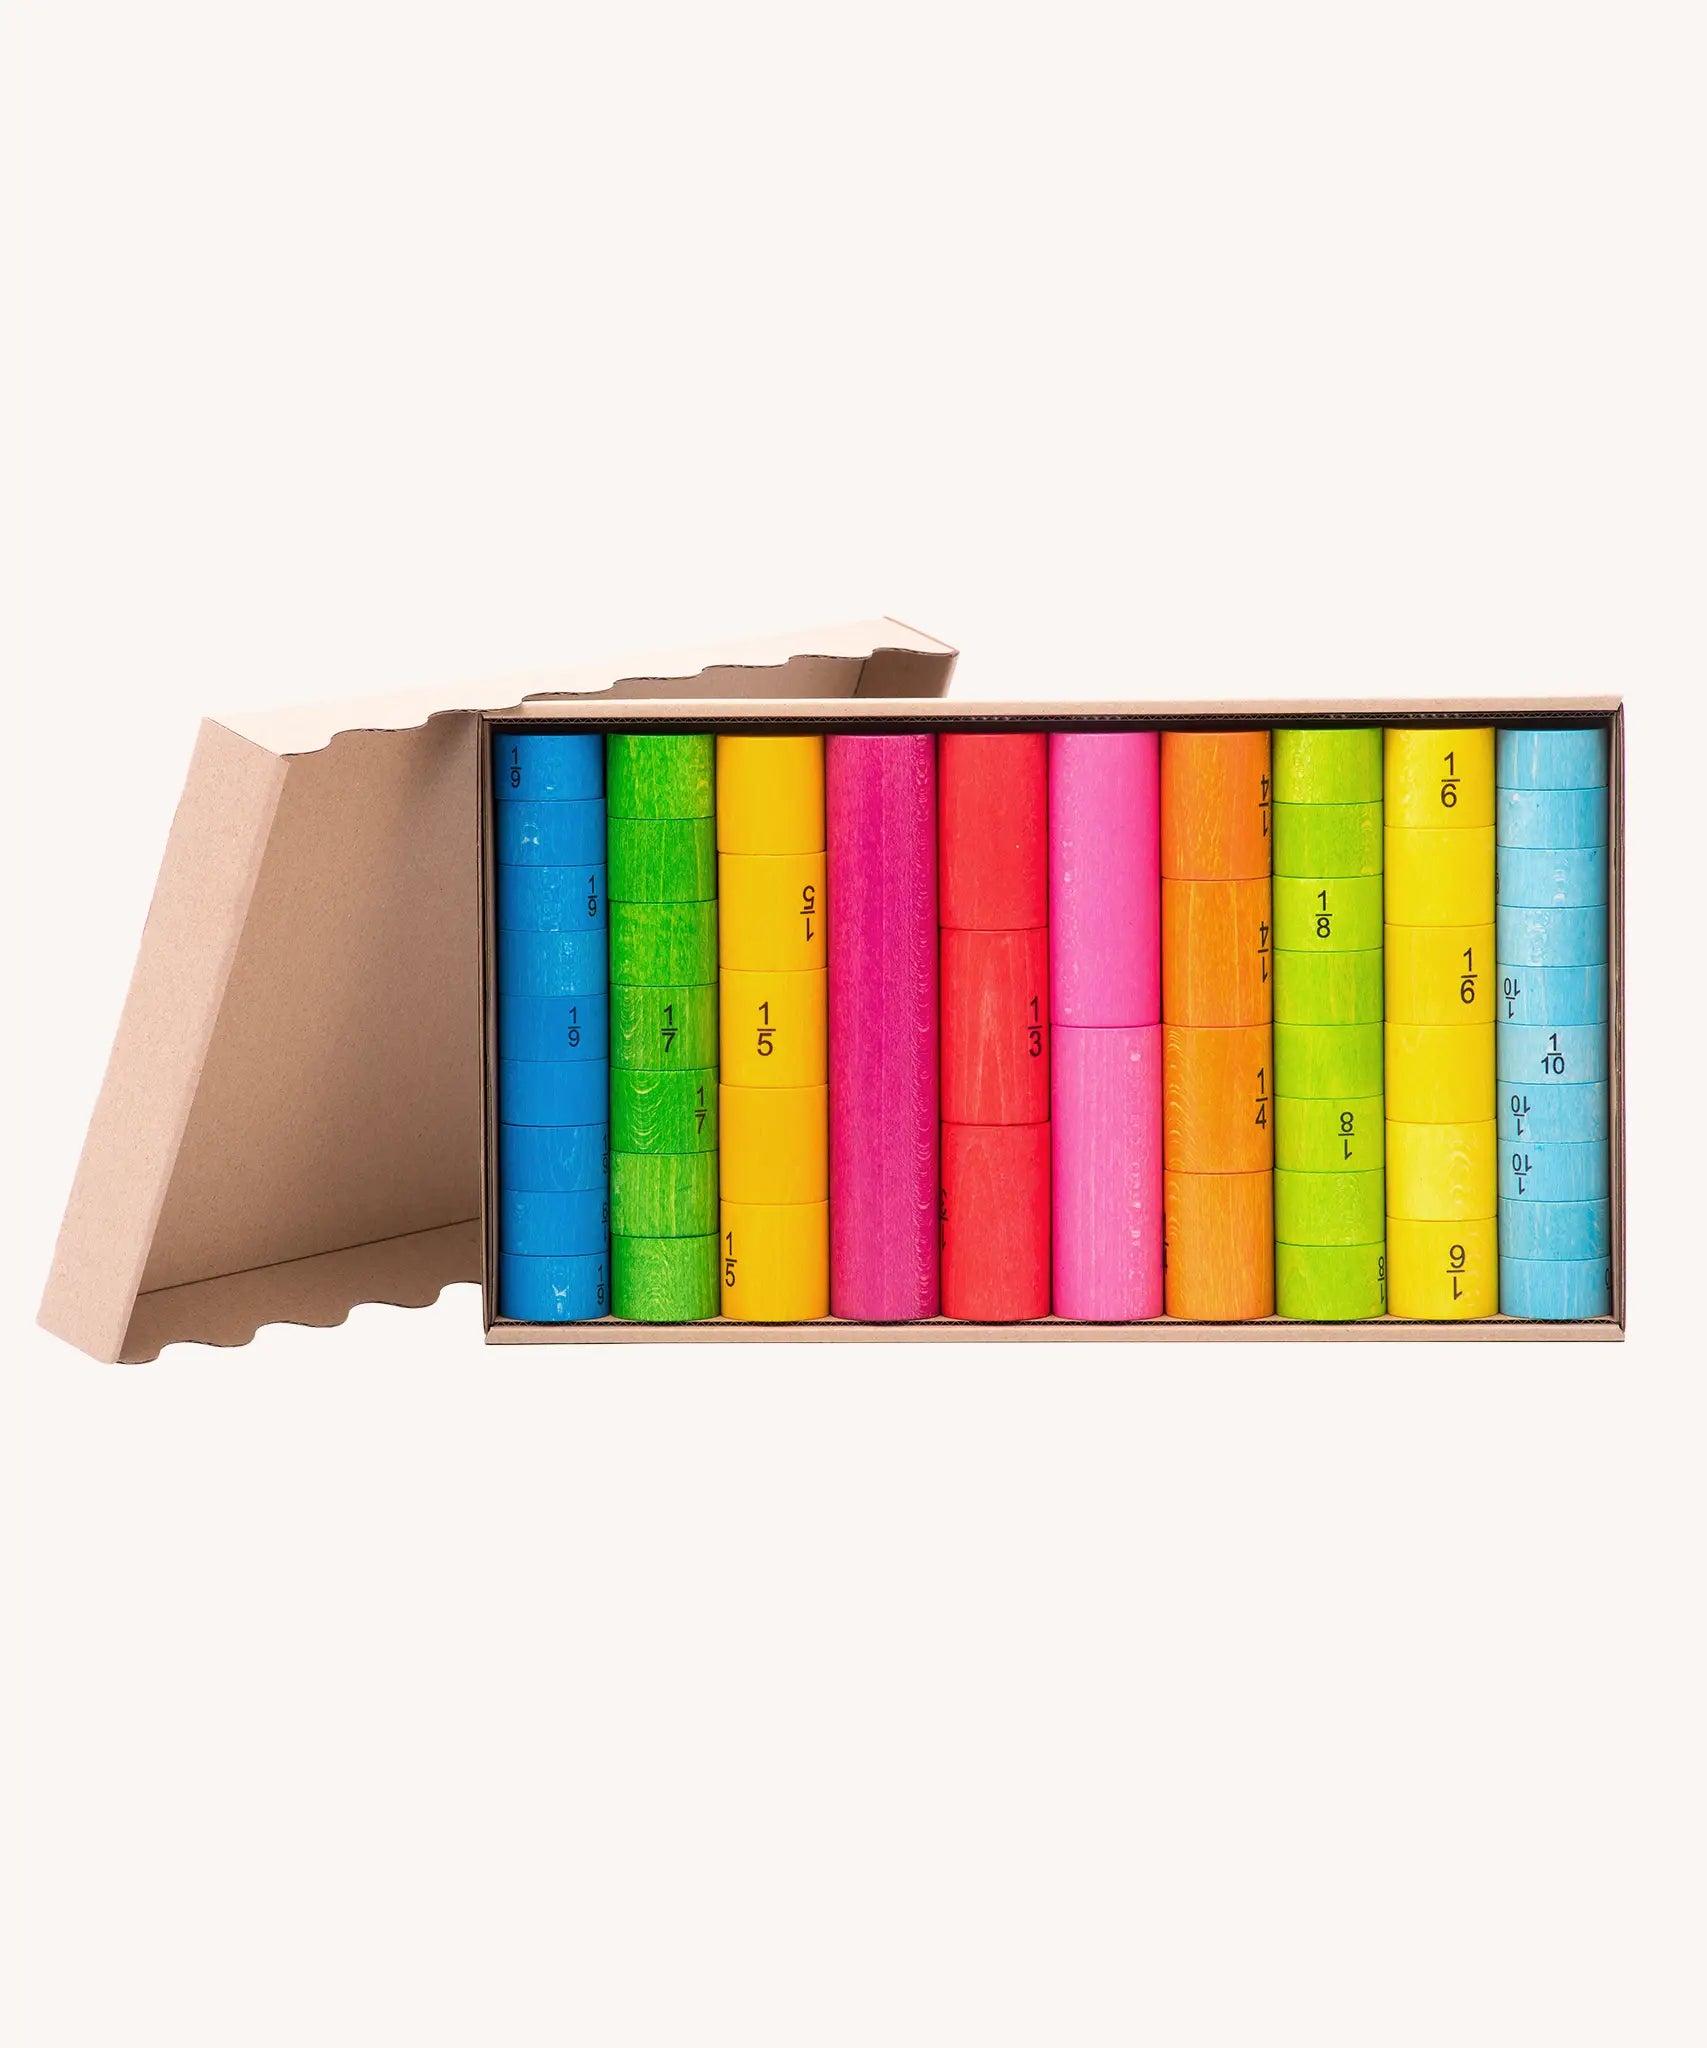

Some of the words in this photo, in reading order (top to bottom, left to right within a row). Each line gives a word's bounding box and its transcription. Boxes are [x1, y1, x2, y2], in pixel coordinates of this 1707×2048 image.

[1444, 751, 1454, 776] 1
[1441, 783, 1457, 808] 6
[1317, 890, 1327, 911] 1
[1316, 917, 1330, 939] 8
[1463, 947, 1472, 972] 1
[1460, 979, 1475, 1005] 6
[569, 1006, 577, 1024] 1
[664, 1004, 673, 1026] 1
[758, 1002, 769, 1025] 1
[1030, 996, 1038, 1022] 1
[568, 1029, 580, 1047] 9
[663, 1032, 676, 1052] 7
[757, 1033, 773, 1057] 5
[1030, 1031, 1042, 1057] 3
[1549, 1033, 1557, 1051] 1
[1541, 1056, 1565, 1075] 10
[1340, 1111, 1353, 1133] 8
[725, 1263, 735, 1287] 5
